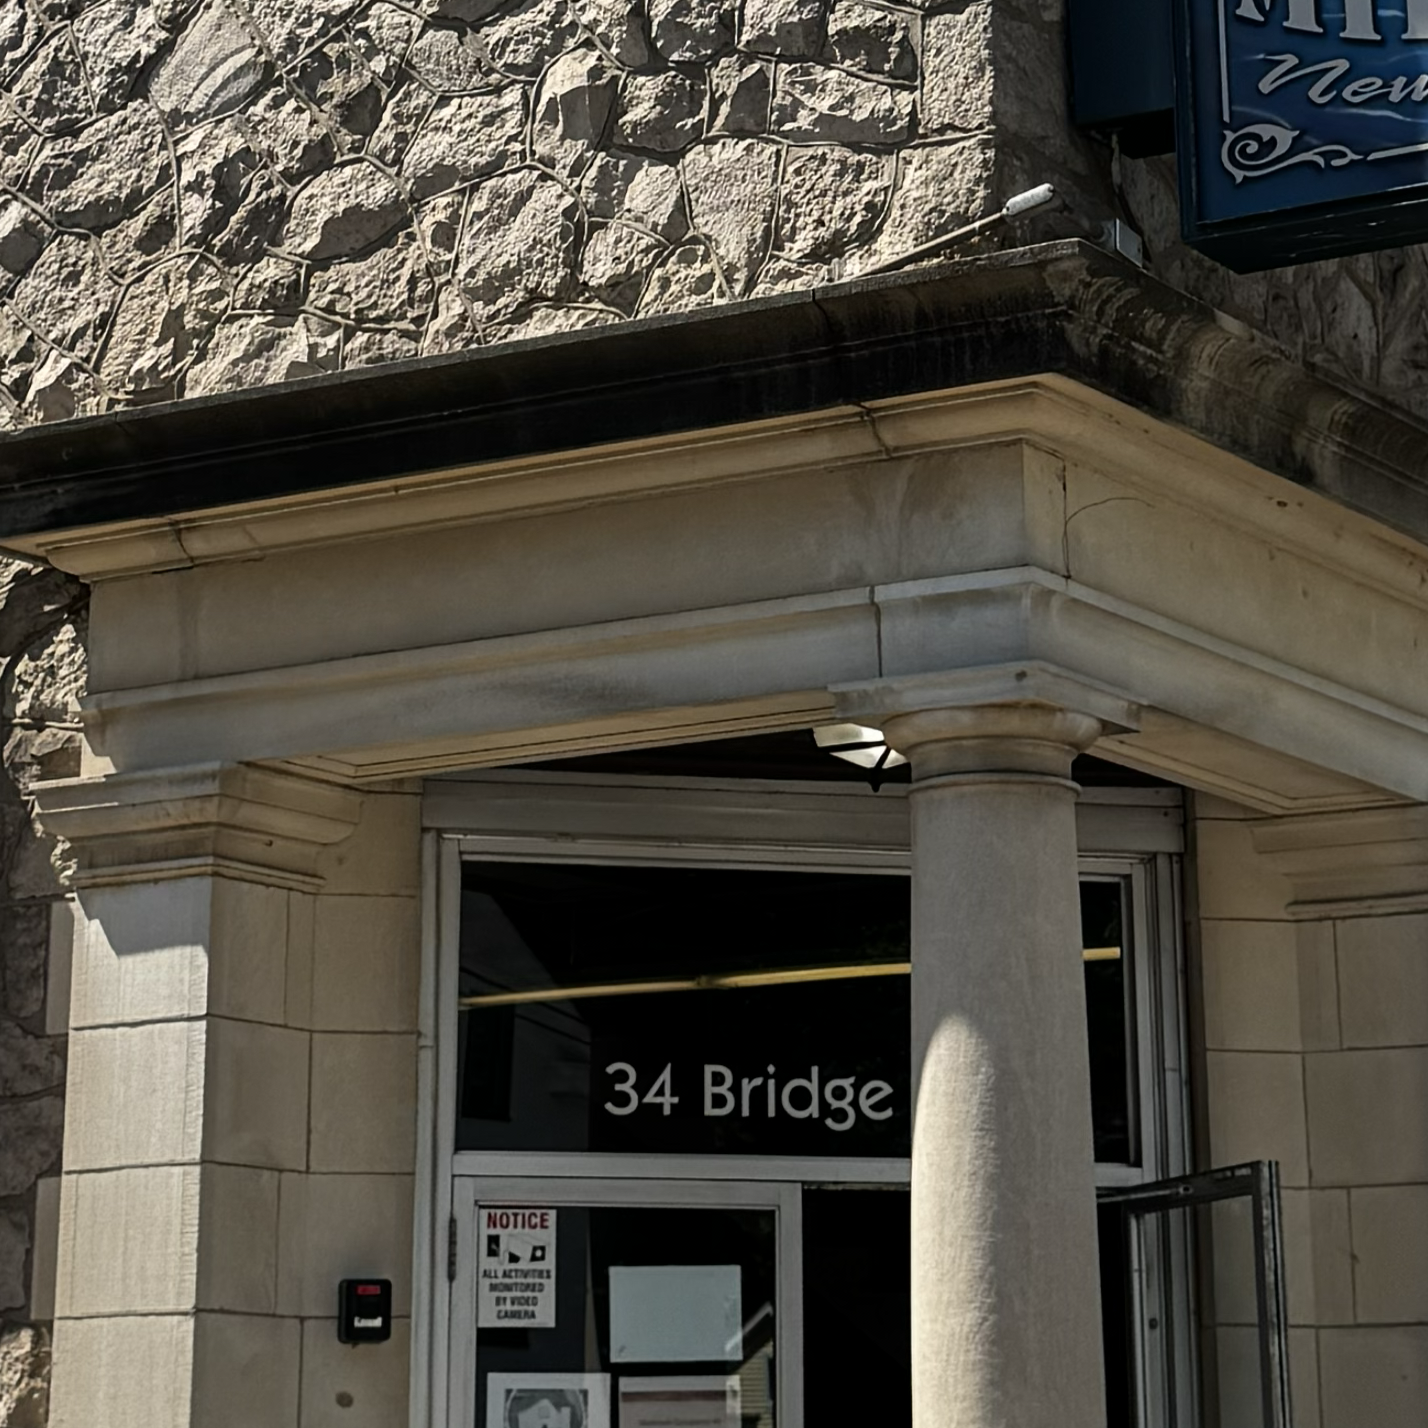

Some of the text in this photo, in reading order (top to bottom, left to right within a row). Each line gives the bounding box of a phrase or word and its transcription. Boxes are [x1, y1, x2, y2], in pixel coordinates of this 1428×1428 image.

[603, 1061, 895, 1132] 34 Bridge
[486, 1212, 550, 1230] NOTICE
[482, 1269, 499, 1280] ALL
[489, 1282, 545, 1293] MONITORED
[495, 1296, 539, 1307] BY VIDEO
[496, 1309, 537, 1320] CAMERA
